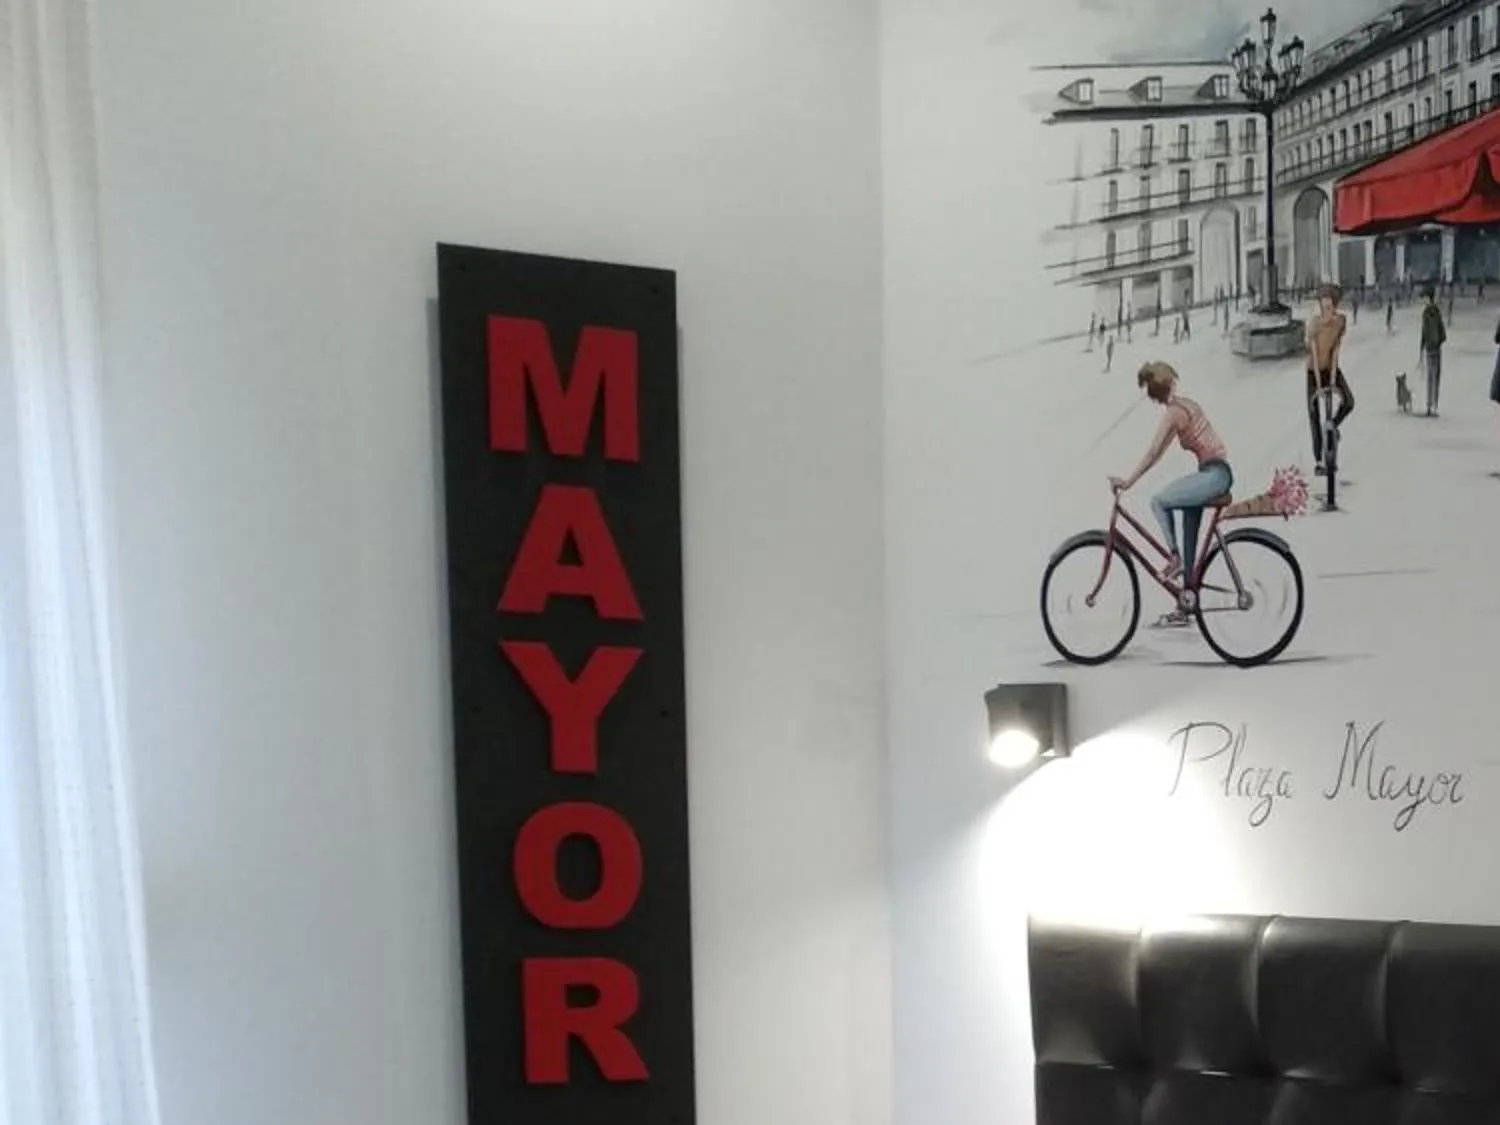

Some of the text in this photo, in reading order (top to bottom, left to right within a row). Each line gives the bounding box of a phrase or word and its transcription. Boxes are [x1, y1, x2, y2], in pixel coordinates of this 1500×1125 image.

[486, 315, 649, 1085] MAYOR
[1168, 720, 1464, 831] Plaza Mayor
